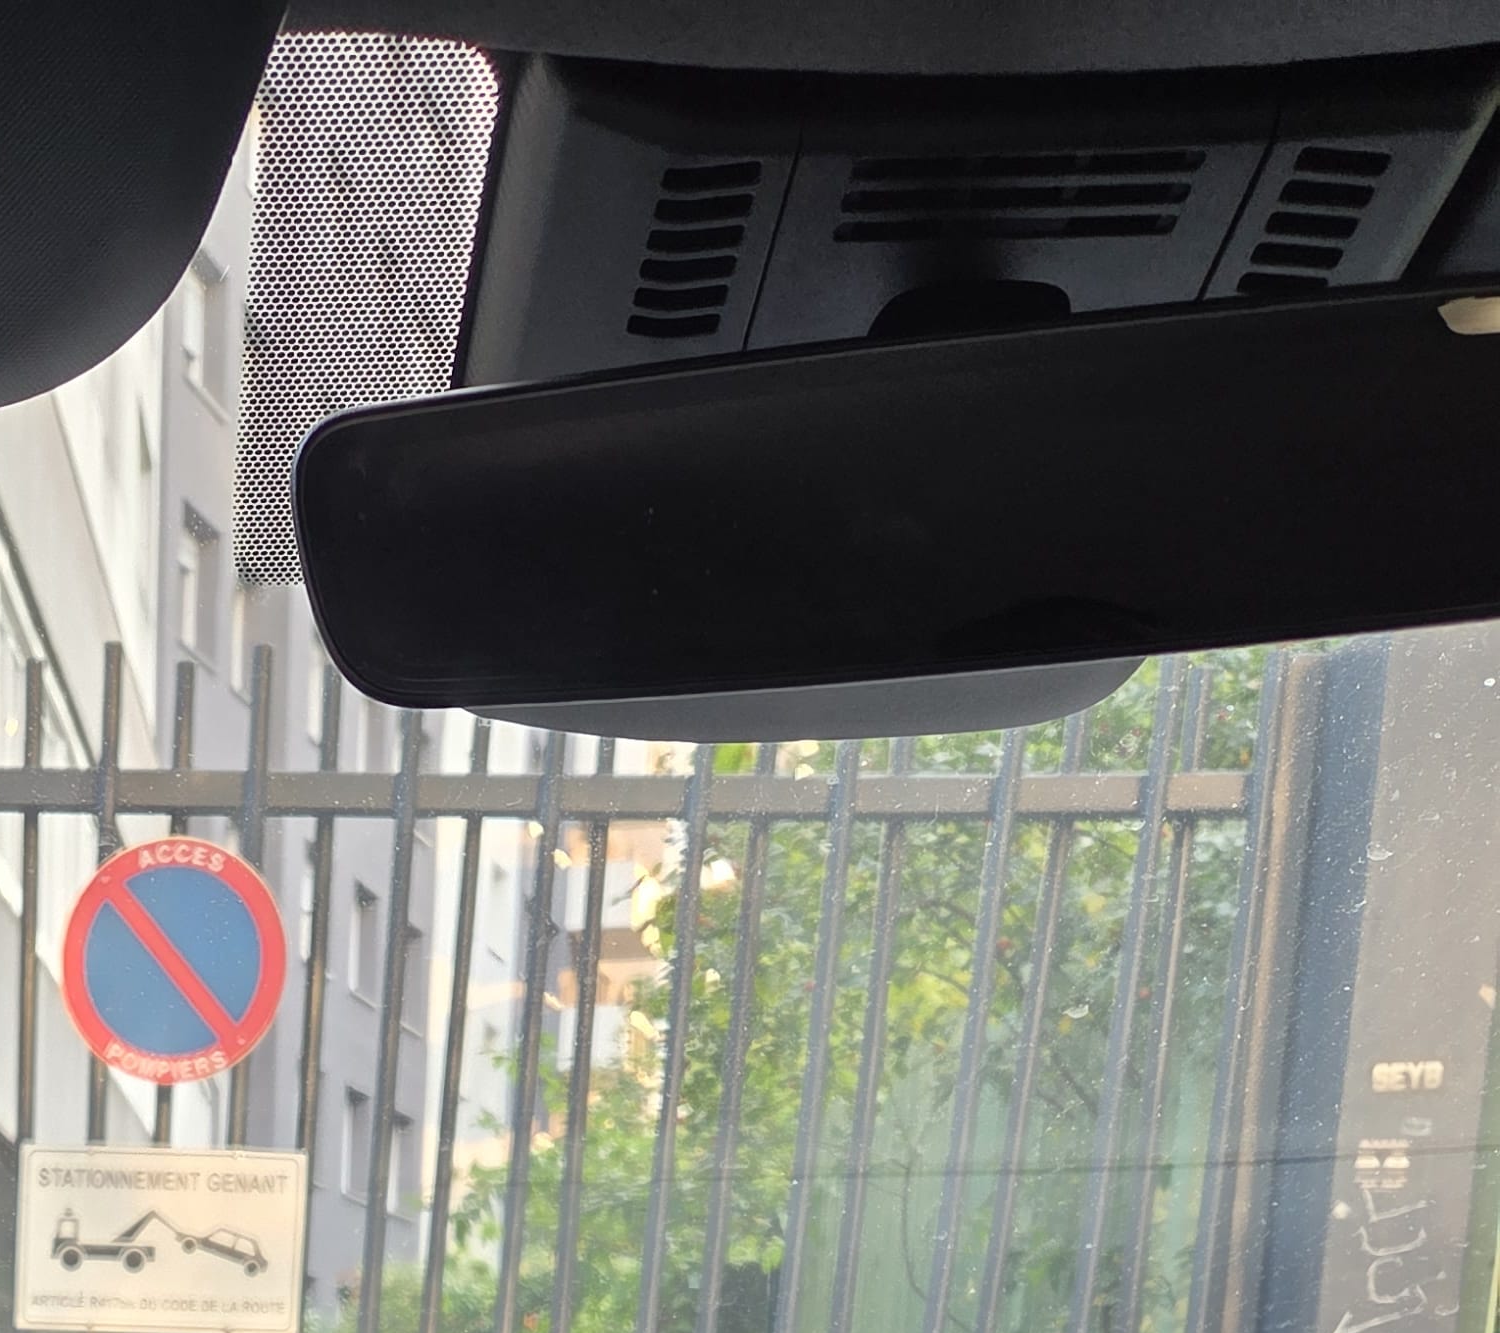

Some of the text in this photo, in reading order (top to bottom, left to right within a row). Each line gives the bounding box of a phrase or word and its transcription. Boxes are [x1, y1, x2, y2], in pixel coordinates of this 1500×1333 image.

[105, 1042, 228, 1079] POMPIERS
[38, 1168, 200, 1190] STATIONNEMENT
[163, 1299, 197, 1312] CODE
[202, 1300, 218, 1313] DE
[243, 1301, 286, 1314] ROUTE
